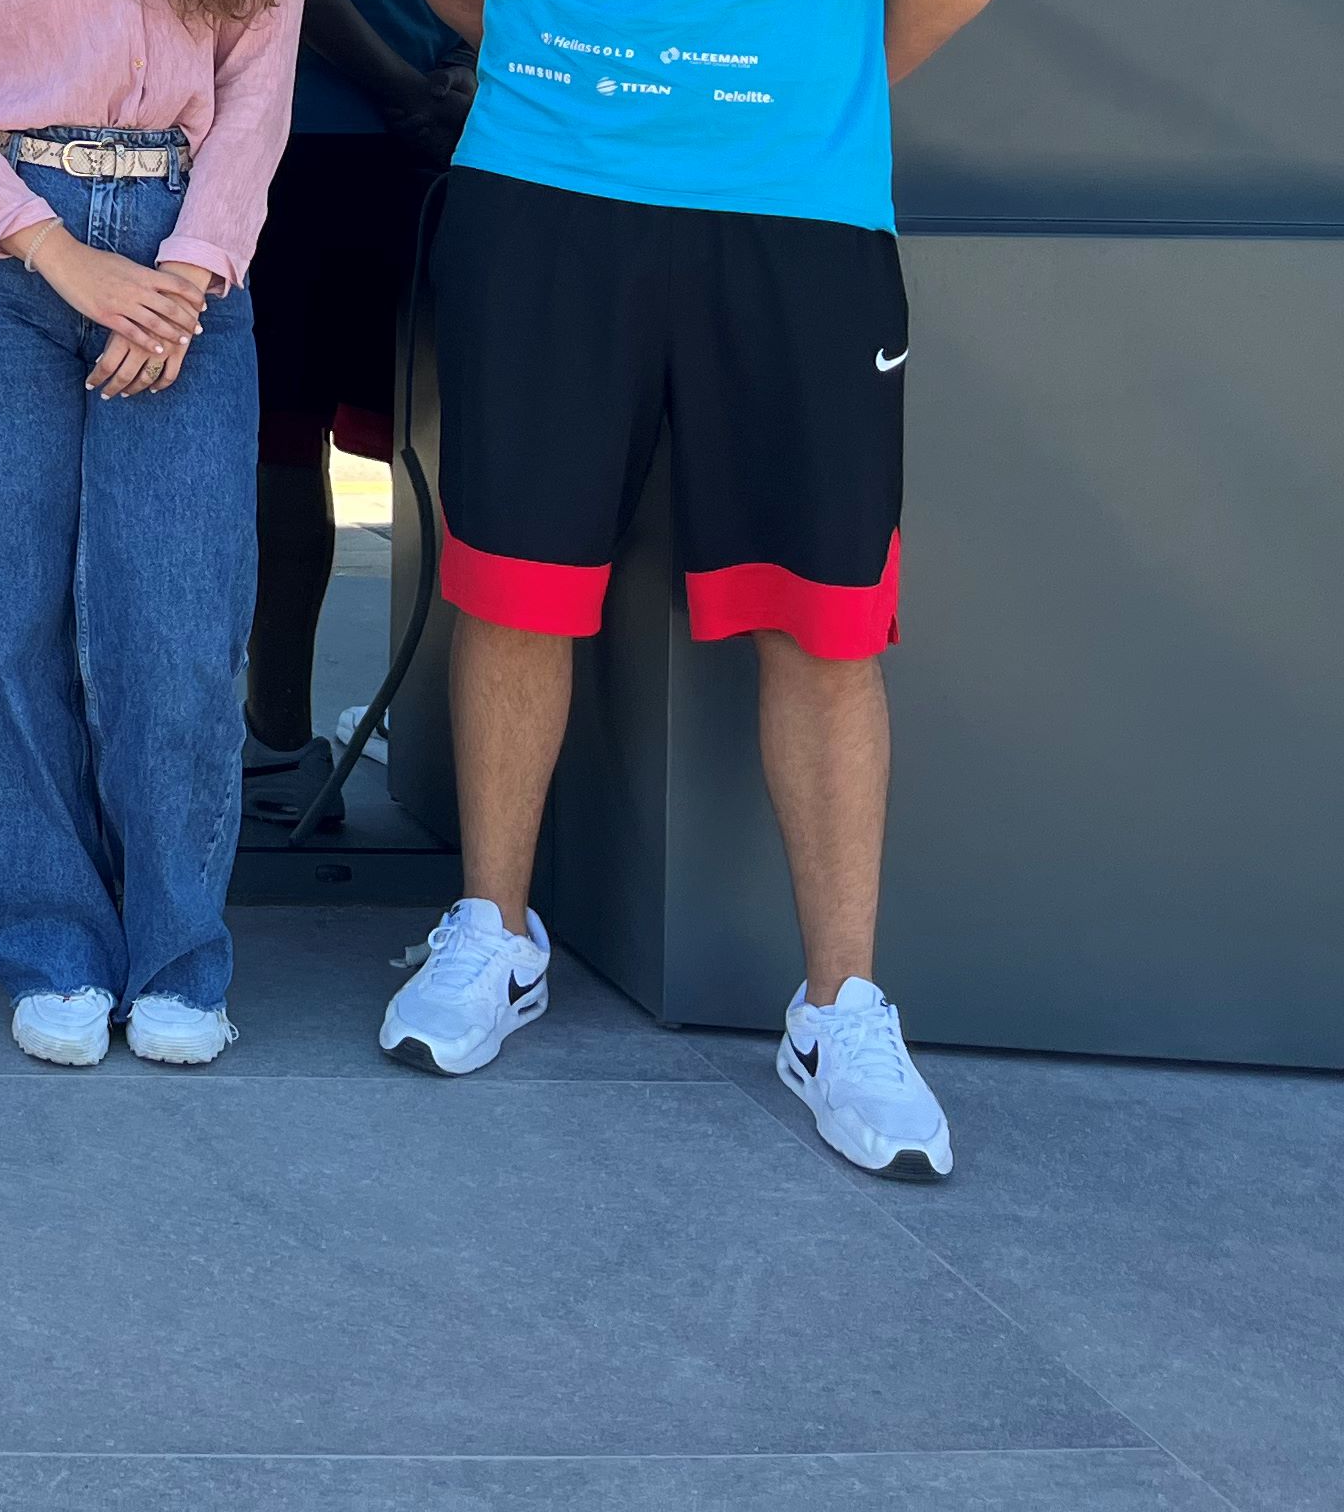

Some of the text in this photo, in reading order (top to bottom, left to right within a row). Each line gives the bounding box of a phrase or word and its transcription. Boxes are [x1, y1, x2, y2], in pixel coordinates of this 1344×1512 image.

[682, 51, 758, 65] KLEEMANN
[509, 63, 570, 84] SAMSUNG
[621, 83, 671, 94] TITAN
